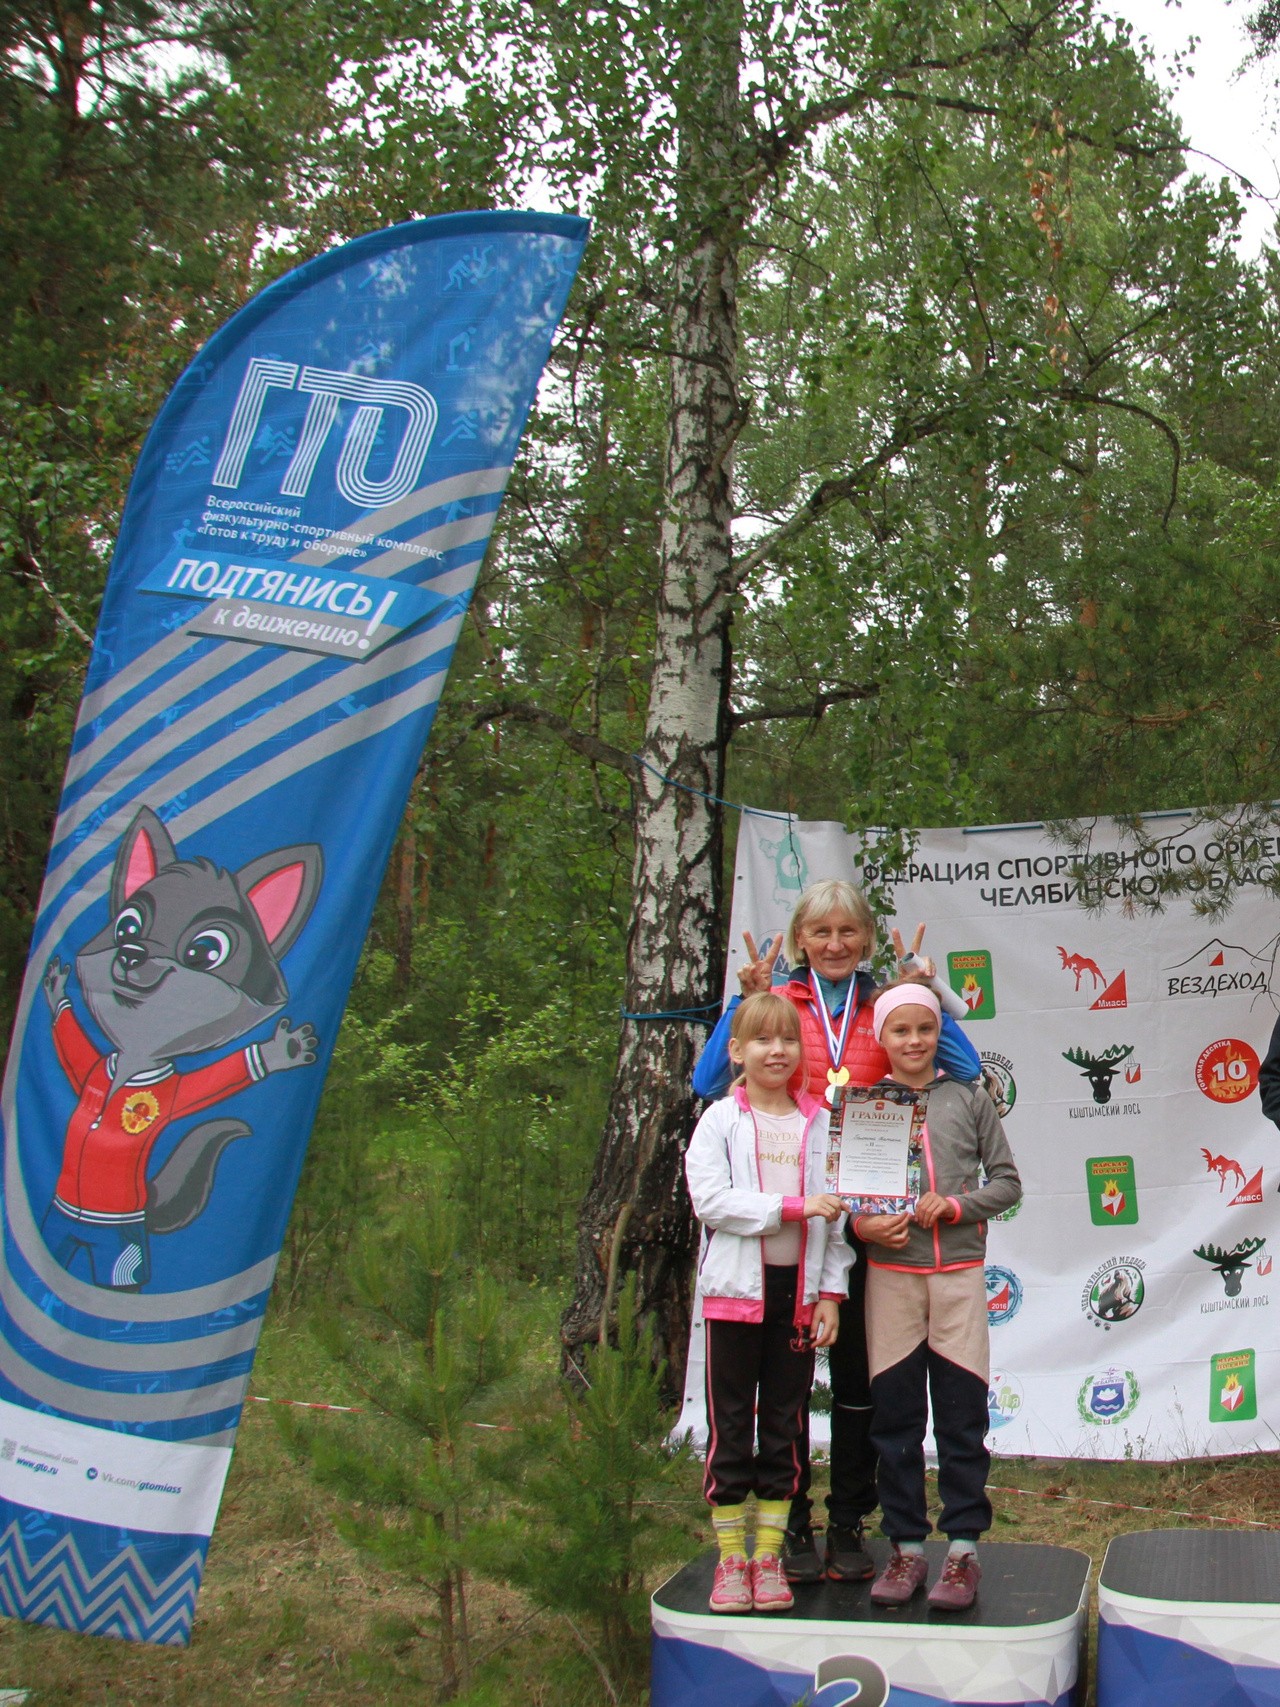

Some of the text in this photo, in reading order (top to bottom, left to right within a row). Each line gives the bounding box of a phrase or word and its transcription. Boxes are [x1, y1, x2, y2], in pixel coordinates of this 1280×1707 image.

[212, 358, 438, 508] ГТО
[206, 495, 301, 518] Всероссийский
[197, 522, 367, 559] «Готов к труду и обороне»
[202, 510, 443, 560] физкультурно-спортивный комплекс
[998, 844, 1196, 880] СПОРТИВНОГО
[1167, 971, 1268, 999] ВЕЗДЕХОД
[1098, 999, 1126, 1008] Миасс
[980, 1051, 1014, 1071] МЕДВЕДЬ
[1196, 1040, 1231, 1091] ГОРЯЧАЯ ДЕСЯТКА
[1211, 1060, 1248, 1082] 10
[850, 1111, 904, 1122] ГРАМОТА
[1068, 1103, 1142, 1119] КЫШТЫМСКИЙ ЛОСЬ
[1234, 1193, 1262, 1204] Миасс
[1081, 1256, 1147, 1312] ЧЕБАРКУЛЬСКИЙ МЕДВЕДЬ
[1200, 1295, 1270, 1314] КЫШТЫМСКИЙ ЛОСЬ
[16, 1457, 59, 1475] www.gto.ru
[102, 1472, 183, 1495] Vk.com/gtomiass
[815, 1653, 890, 1707] 2
